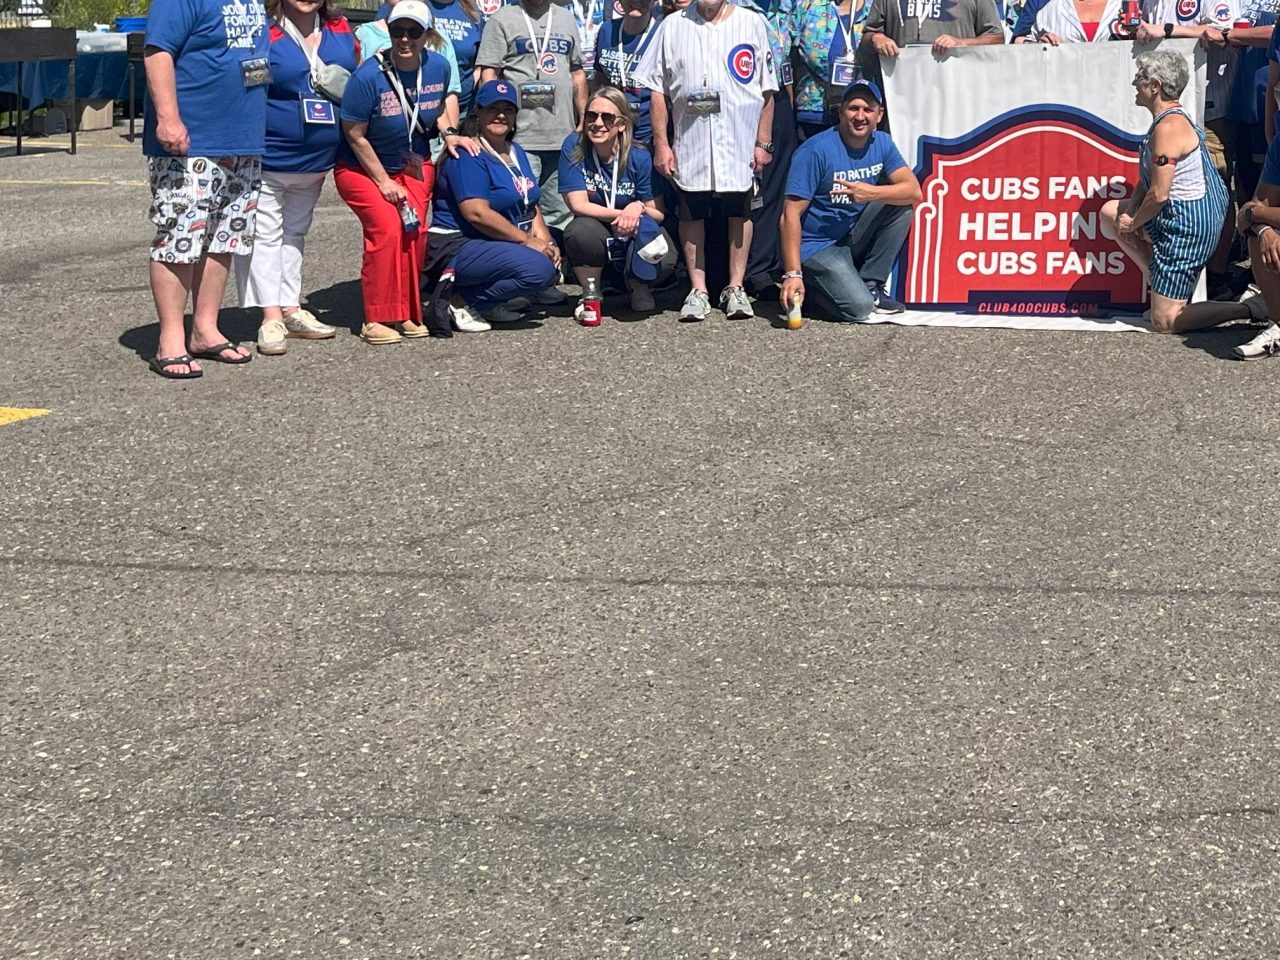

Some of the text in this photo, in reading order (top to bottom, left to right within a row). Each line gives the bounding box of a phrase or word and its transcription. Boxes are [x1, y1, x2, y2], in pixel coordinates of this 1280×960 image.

[961, 175, 1127, 201] CUBS FANS
[959, 211, 1097, 241] HELPIN
[957, 251, 1125, 275] CUBS FANS
[977, 301, 1098, 314] CLUB400CUBS.COM
